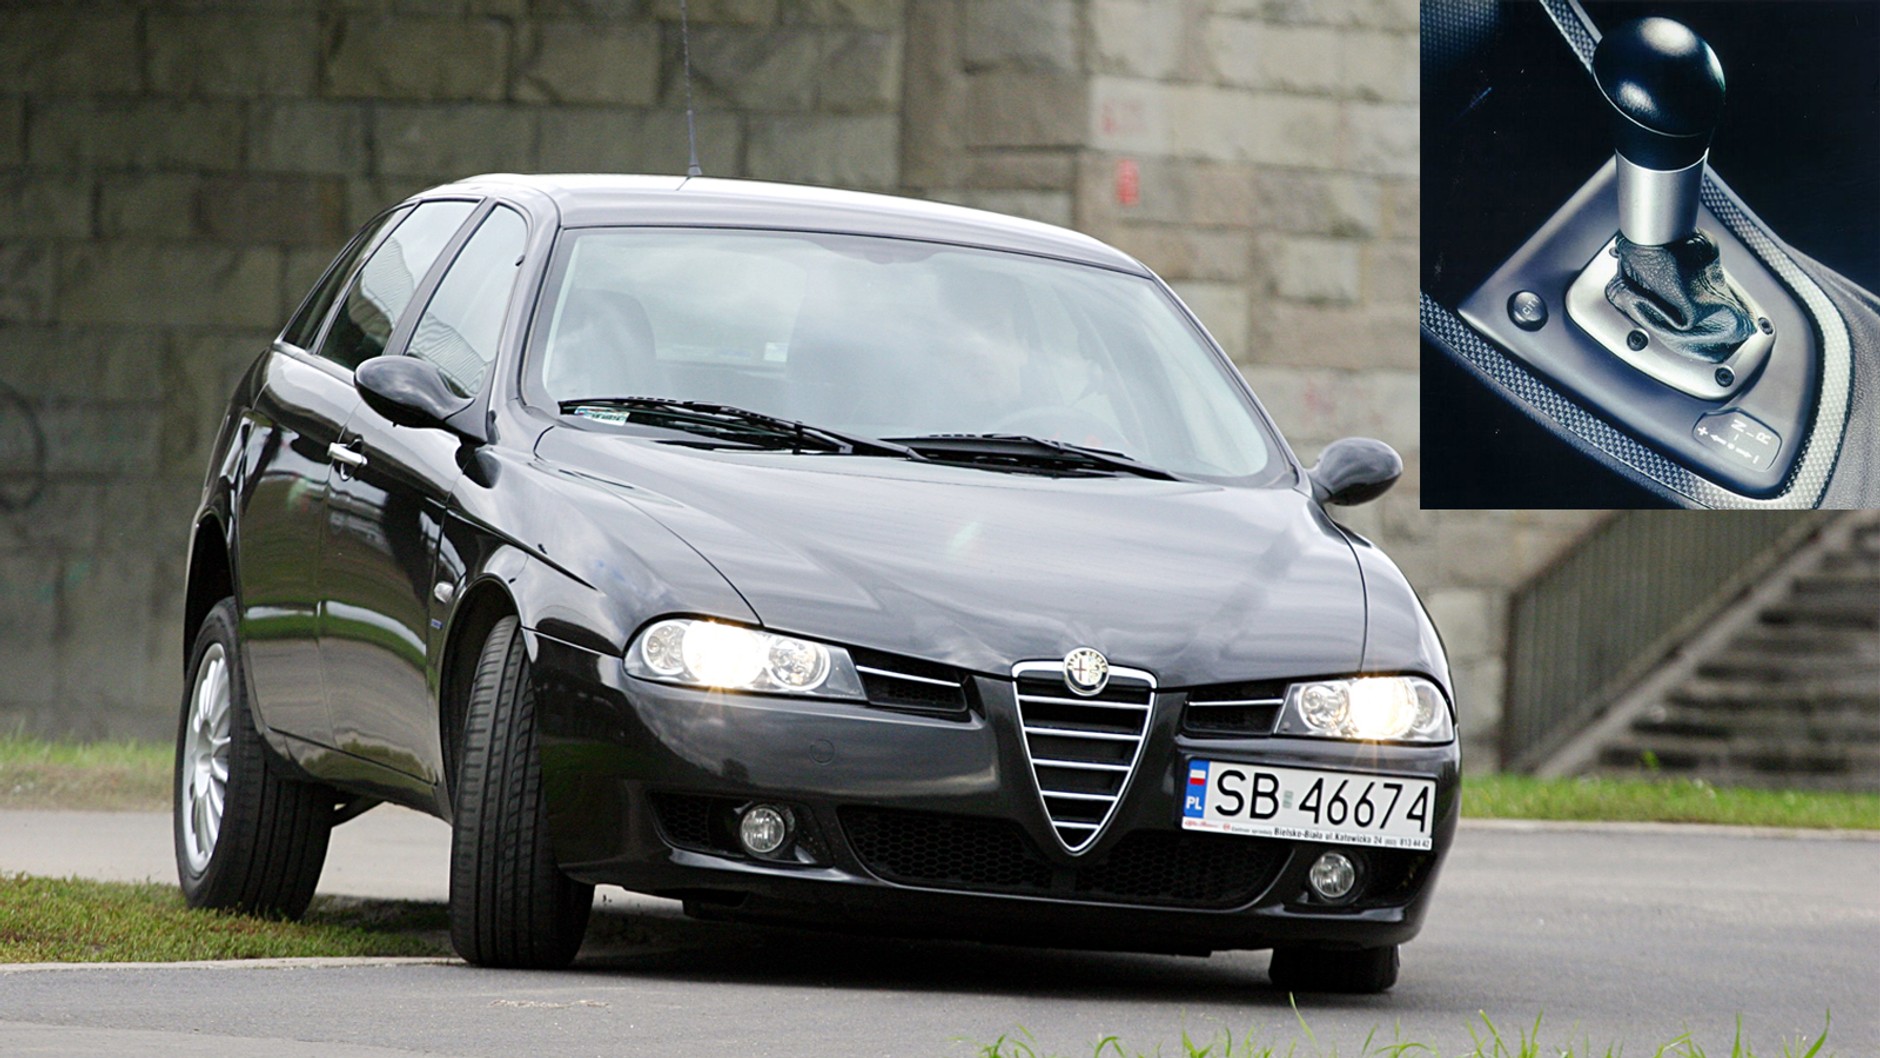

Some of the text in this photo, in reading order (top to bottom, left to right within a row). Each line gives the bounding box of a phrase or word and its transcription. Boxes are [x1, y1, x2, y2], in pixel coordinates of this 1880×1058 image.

[1522, 297, 1540, 315] CITY
[1731, 419, 1747, 433] N
[1756, 431, 1772, 445] R
[1185, 795, 1203, 810] PL
[1215, 769, 1429, 833] SB 46674
[1374, 837, 1382, 845] 24
